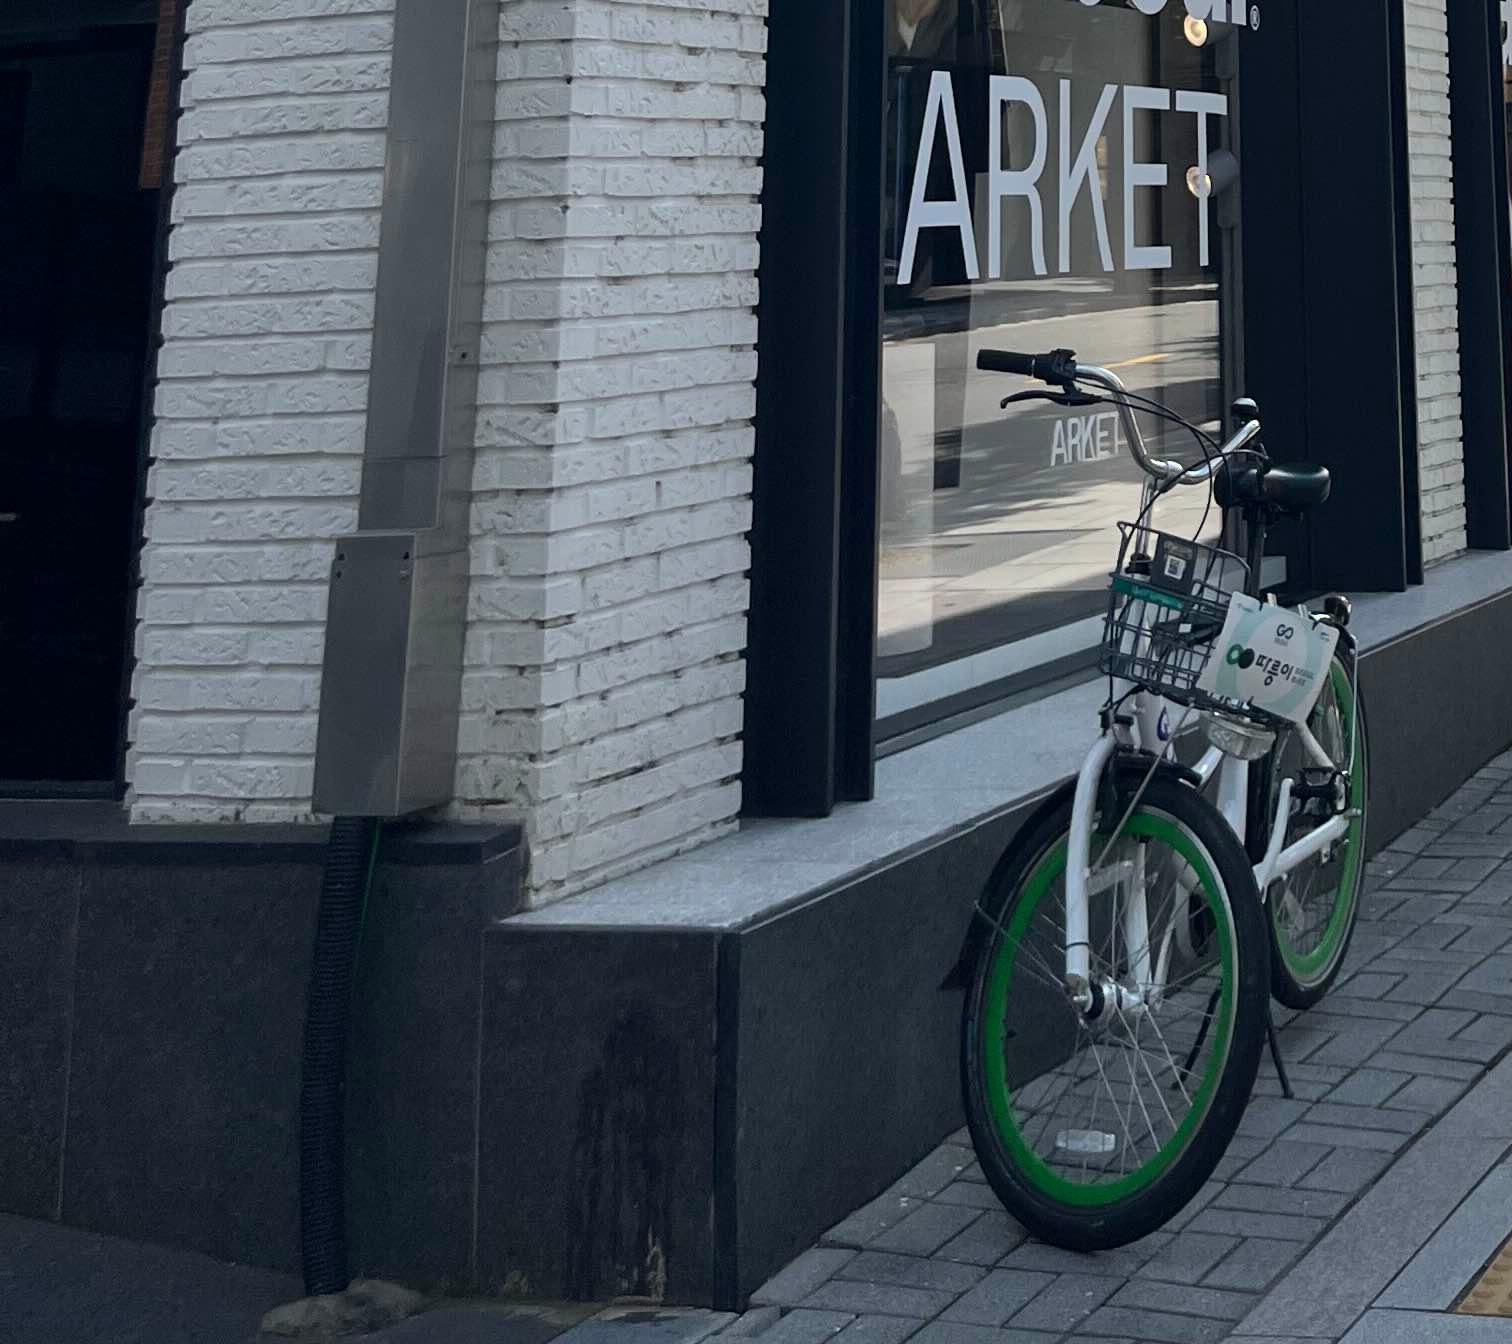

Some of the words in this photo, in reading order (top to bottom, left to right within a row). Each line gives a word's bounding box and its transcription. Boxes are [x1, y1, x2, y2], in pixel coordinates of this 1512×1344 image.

[897, 70, 1227, 286] ARKET
[1050, 410, 1120, 468] ARKET
[1255, 653, 1295, 687] 따릉이
